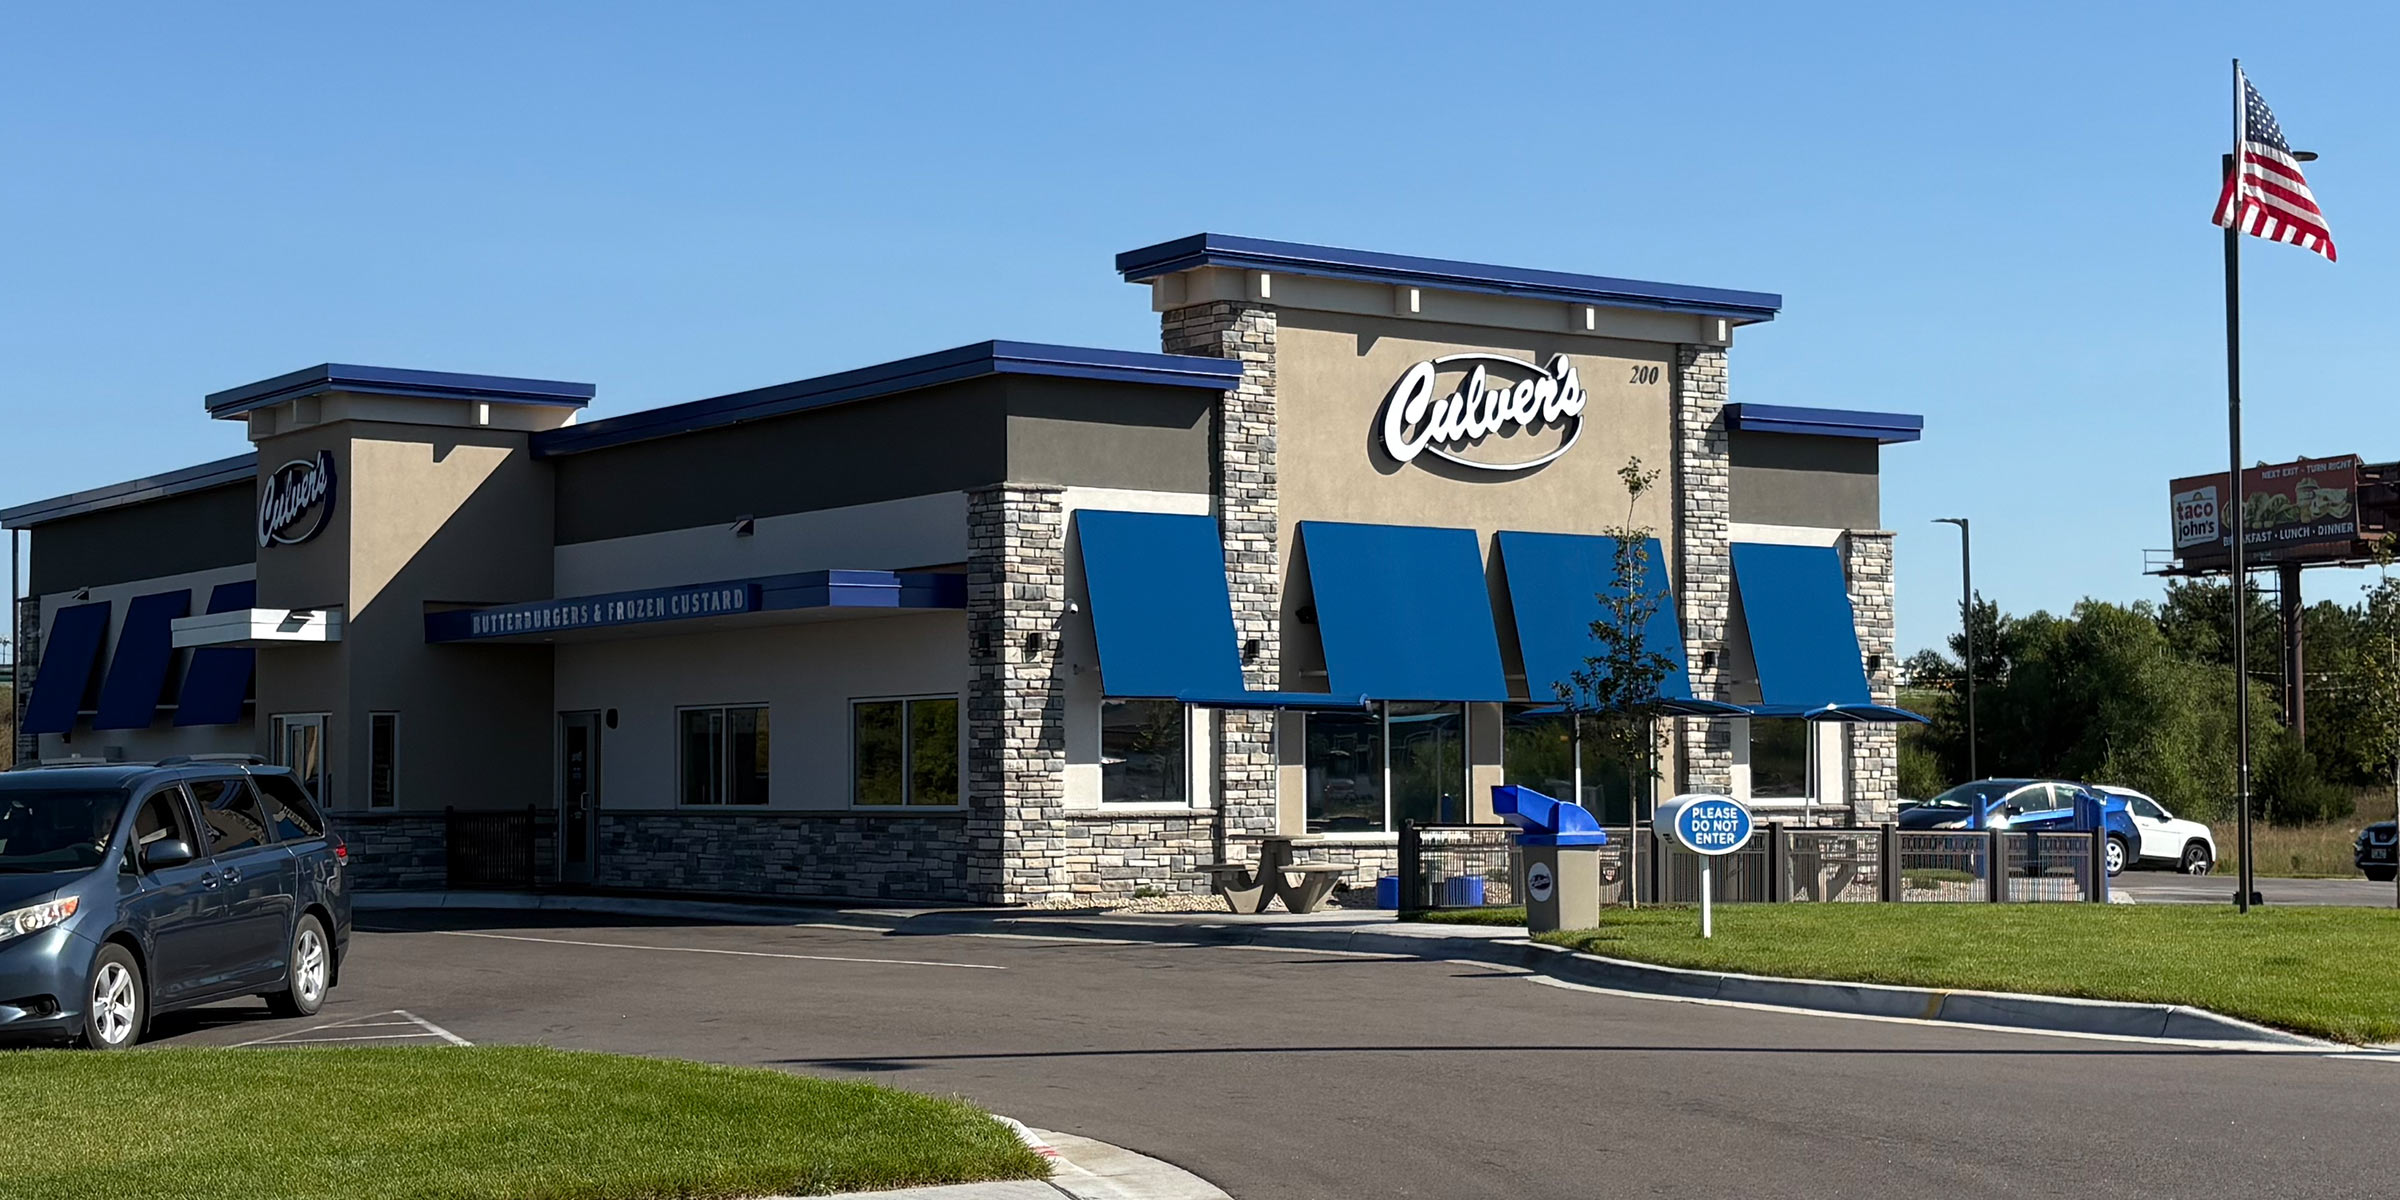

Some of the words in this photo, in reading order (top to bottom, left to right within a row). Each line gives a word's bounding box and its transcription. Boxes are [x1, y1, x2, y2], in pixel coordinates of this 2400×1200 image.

[1629, 365, 1659, 385] 200
[1383, 353, 1588, 462] Culver's
[258, 450, 328, 548] Culver's
[2176, 502, 2213, 520] taco
[2178, 520, 2215, 541] john's
[2280, 526, 2310, 540] LUNCH
[2318, 522, 2354, 536] DINNER
[473, 604, 588, 634] BUTTERBURGERS
[593, 603, 602, 622] &
[608, 597, 665, 621] FROZEN
[671, 588, 743, 615] CUSTARD
[1692, 807, 1737, 819] PLEASE
[1691, 820, 1710, 832] DO
[1713, 820, 1738, 832] NOT
[1695, 832, 1735, 844] ENTER
